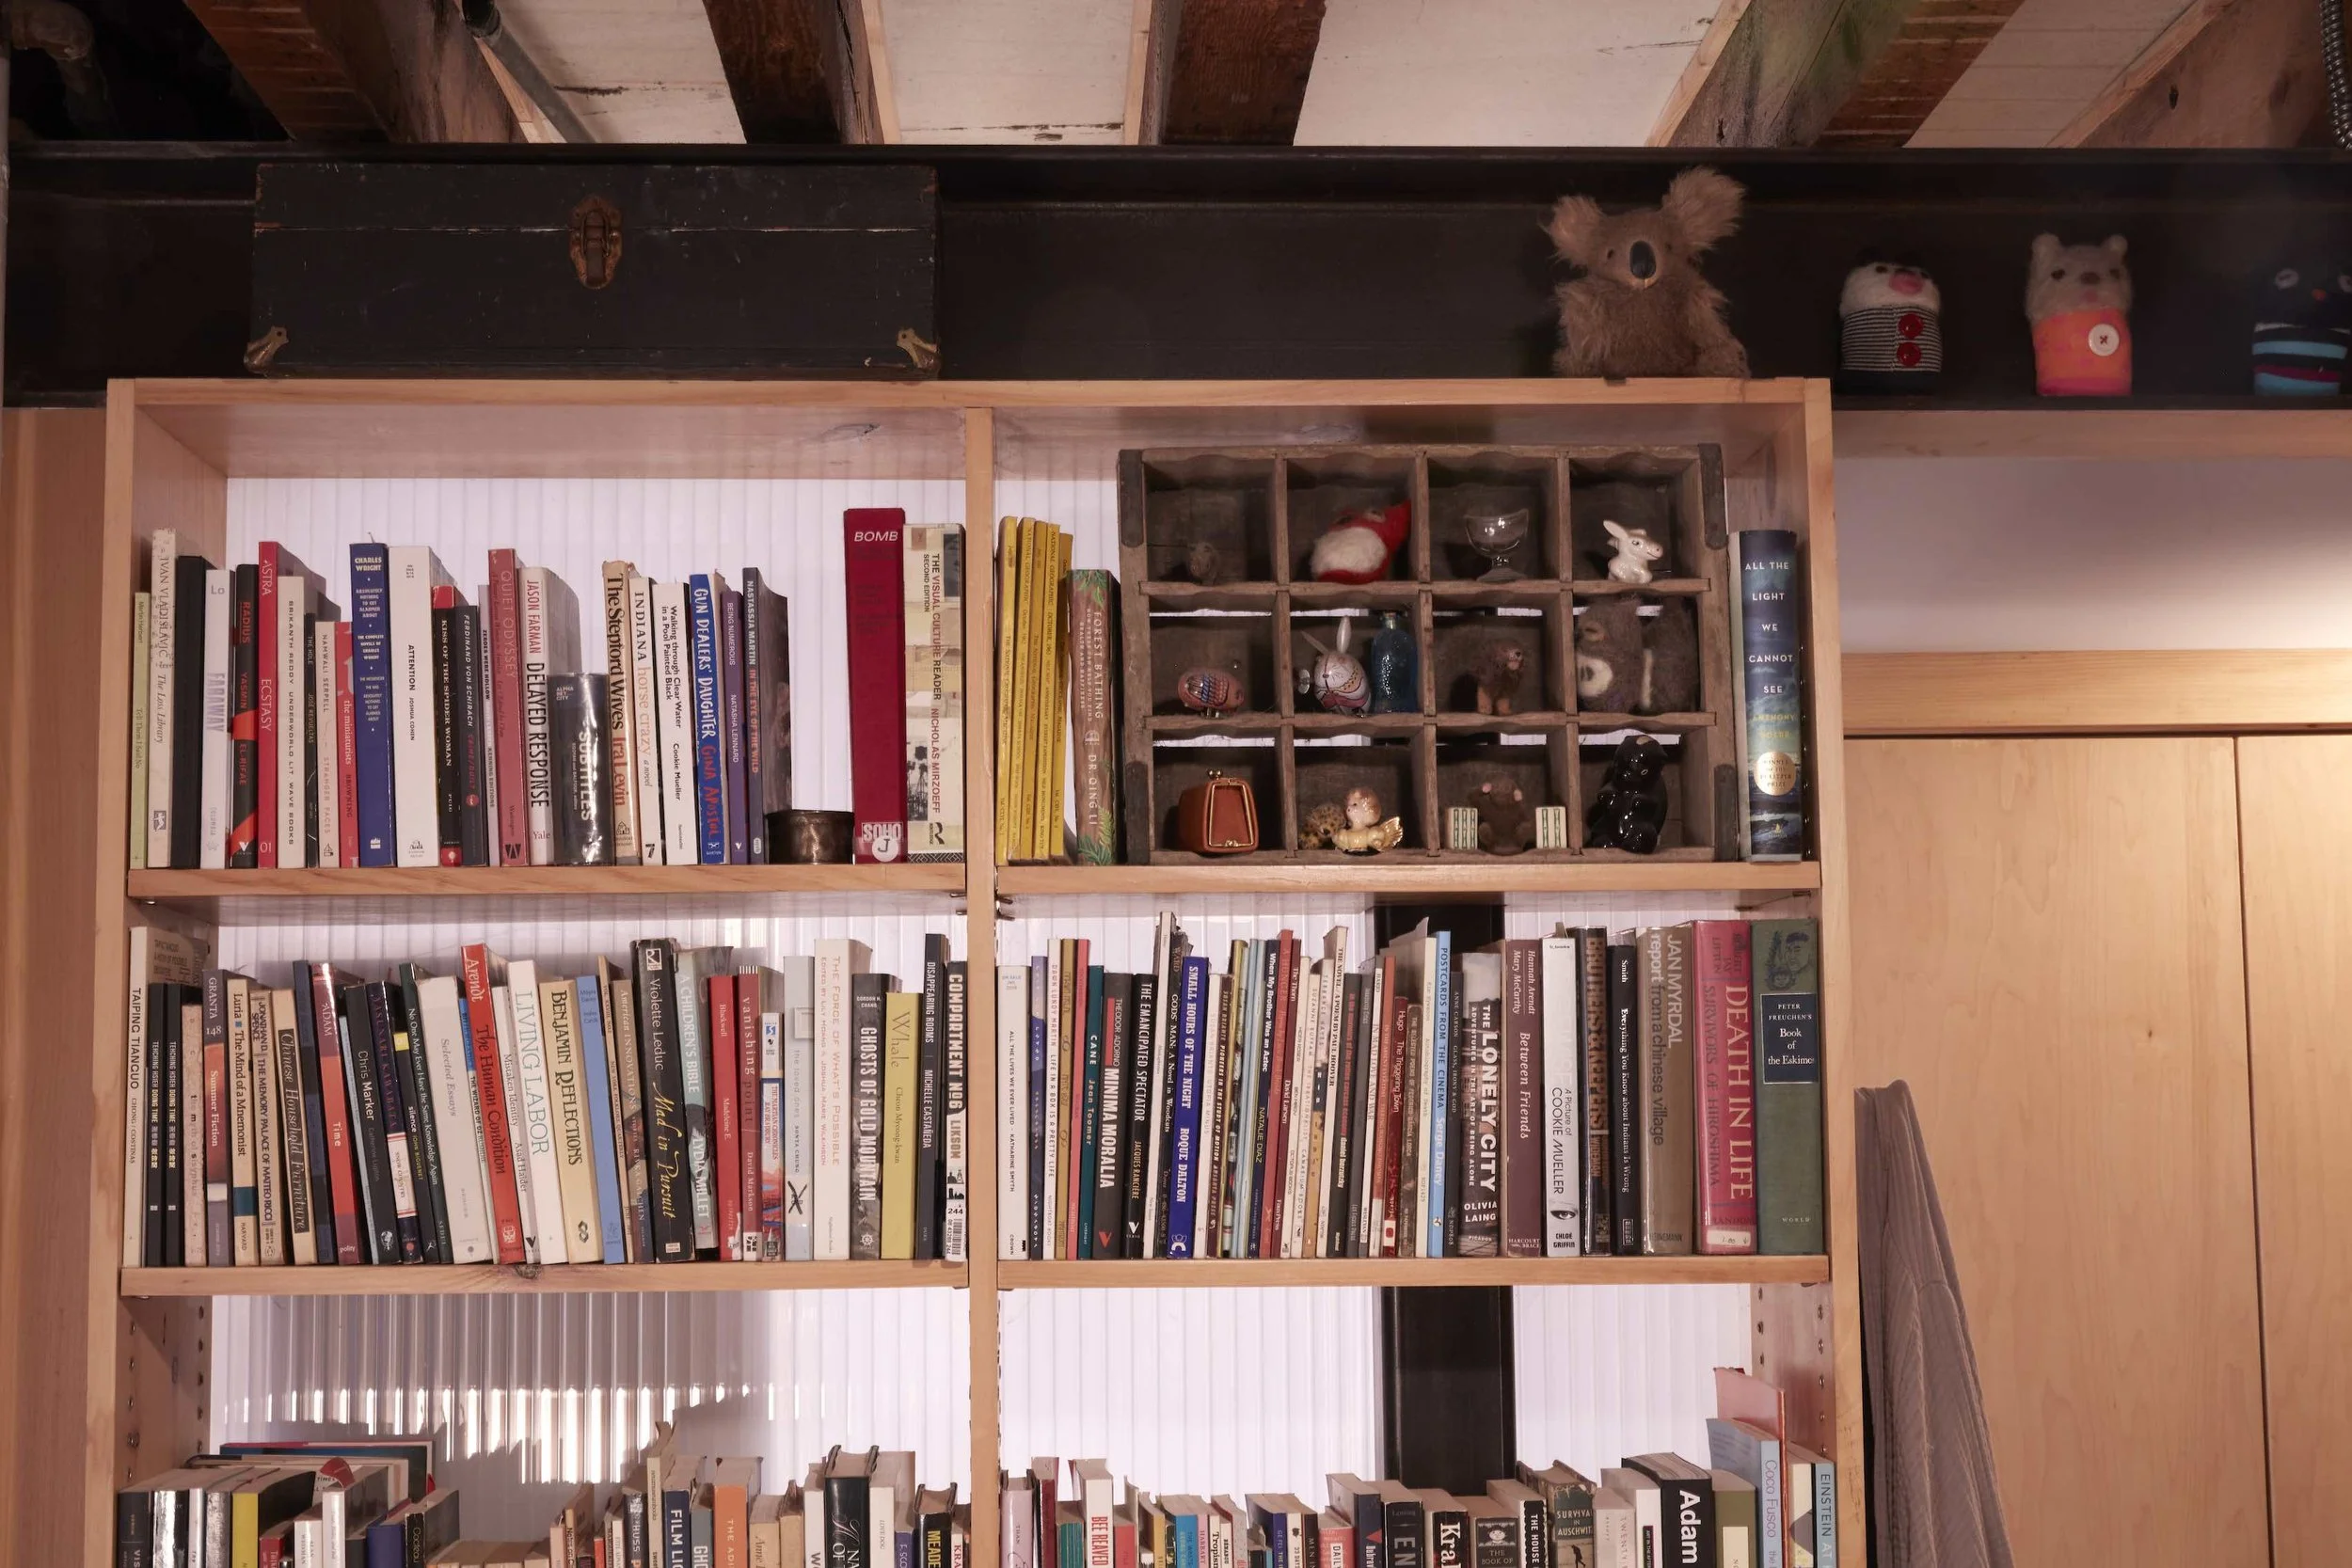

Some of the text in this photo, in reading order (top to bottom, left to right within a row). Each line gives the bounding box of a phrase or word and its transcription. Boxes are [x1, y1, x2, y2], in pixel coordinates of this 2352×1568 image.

[853, 531, 898, 542] BOMB
[527, 580, 541, 654] JASON FARMAN
[669, 606, 678, 640] Walking
[747, 581, 755, 628] NASTASSJA
[608, 574, 627, 730] The Stepford Wives
[635, 592, 651, 755] INDIANA horse crazy
[670, 642, 679, 674] through
[694, 589, 717, 739] GUN DEALERS' DAUGHTER
[1094, 611, 1103, 719] FOREST BATHING
[1749, 655, 1793, 663] CANNOT
[155, 674, 166, 743] The Loss Library
[206, 673, 225, 732] FARAWAY
[261, 679, 272, 731] ECSTASY
[527, 663, 548, 807] DELAYED RESPONSE
[239, 744, 247, 785] EL-RIFAE
[578, 732, 593, 820] SUBTITLES
[931, 762, 940, 814] MIRZOEFF
[209, 977, 217, 1019] GRANTA
[233, 993, 243, 1019] Luria
[466, 958, 482, 1003] Arendt
[925, 962, 935, 1043] DISAPPEARING ROOMS
[1263, 953, 1277, 1071] When My Brother Was an Aztec
[1439, 947, 1448, 1006] POSTCARDS
[1513, 950, 1522, 1014] Mary McCarthy
[1528, 985, 1537, 1014] Arendt
[1667, 935, 1681, 1048] JAN MYRDAL
[130, 988, 141, 1089] TAIPING TIANGUO
[235, 1031, 245, 1053] The
[650, 978, 666, 1070] Violette Leduc
[680, 975, 699, 1093] A CHILDREN'S BIBLE
[948, 974, 962, 1077] COMPARTMENT
[1134, 984, 1152, 1121] THE EMANCIPATED SPECTATOR
[1182, 966, 1199, 1108] SMALL HOURS OF THE NIGHT
[1438, 1012, 1447, 1039] FROM
[1649, 933, 1667, 1145] report from a chinese village
[235, 1054, 246, 1079] Mind
[236, 1081, 246, 1090] of
[358, 1051, 375, 1120] Chris Marker
[476, 1025, 506, 1174] The Human Condition
[515, 991, 549, 1155] LIVING LABOR
[551, 991, 581, 1165] BENJAMIN REFLECTIONS
[1438, 1069, 1446, 1108] CINEMA
[1480, 1006, 1497, 1192] THE LONELY CITY
[1519, 1032, 1532, 1139] Between Friends
[1725, 985, 1753, 1199] DEATH IN LIFE
[210, 1070, 219, 1147] Summer Fiction
[237, 1099, 246, 1156] Mnemonist
[281, 1034, 307, 1230] Chinese Household Furniture
[859, 1027, 877, 1201] GHOSTS OF GOLD MOUNTAIN
[922, 1069, 932, 1148] MICHELLE CASTAÑEDA
[950, 1119, 961, 1159] LIKSOM
[1100, 1069, 1119, 1188] MINIMA MORALIA
[1257, 1107, 1265, 1140] NATALIE
[1551, 1087, 1565, 1194] COOKIE MUELLER
[653, 1083, 682, 1219] Mad in Pursuit
[692, 1139, 708, 1218] LYDIA MILLET
[1177, 1129, 1190, 1202] ROQUE DALTON
[671, 1510, 682, 1545] FILM
[1091, 1517, 1108, 1566] BEE REAVED
[1531, 1514, 1539, 1563] THE HOUSE
[1679, 1490, 1701, 1564] Adam
[1820, 1474, 1831, 1537] EINSTEIN
[412, 1528, 421, 1563] Cocteau
